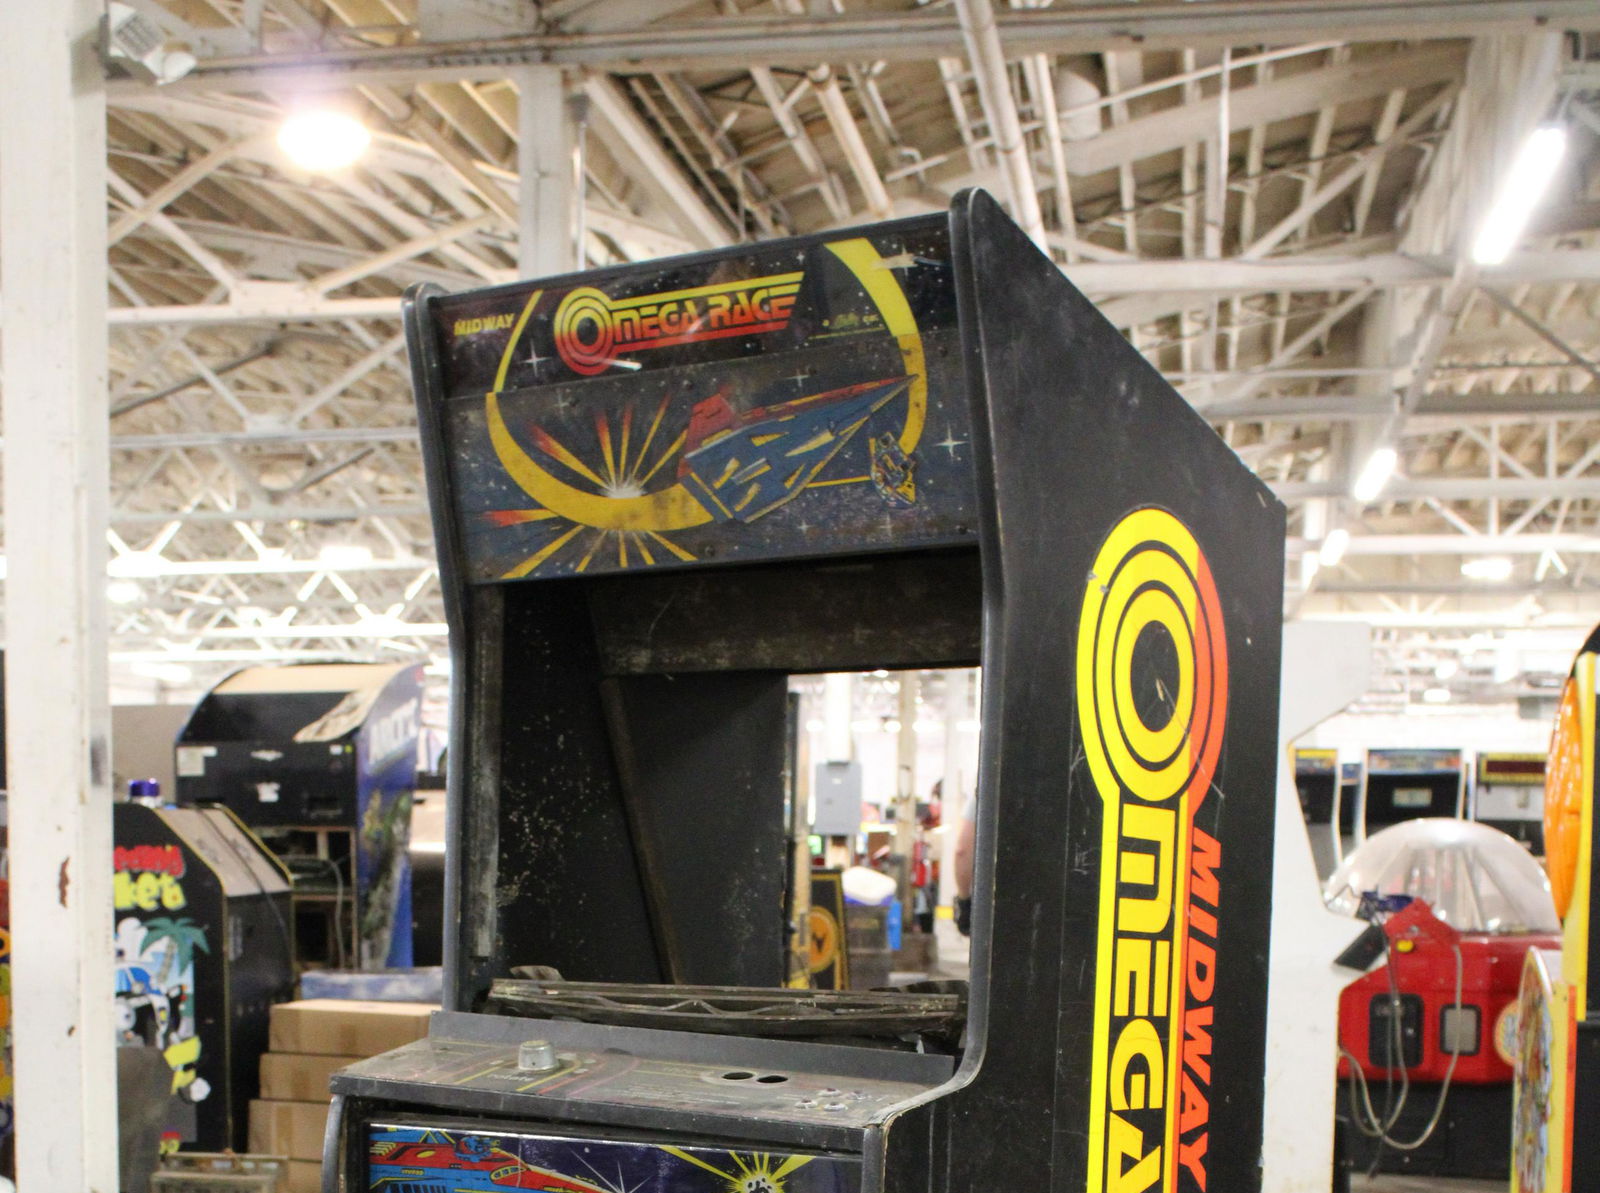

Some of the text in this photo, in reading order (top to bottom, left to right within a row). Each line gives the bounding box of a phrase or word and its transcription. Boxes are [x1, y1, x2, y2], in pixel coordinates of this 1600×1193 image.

[454, 312, 515, 336] MIDWAY
[554, 283, 801, 376] OMEGA RACE
[1179, 827, 1221, 1193] MIDWAY
